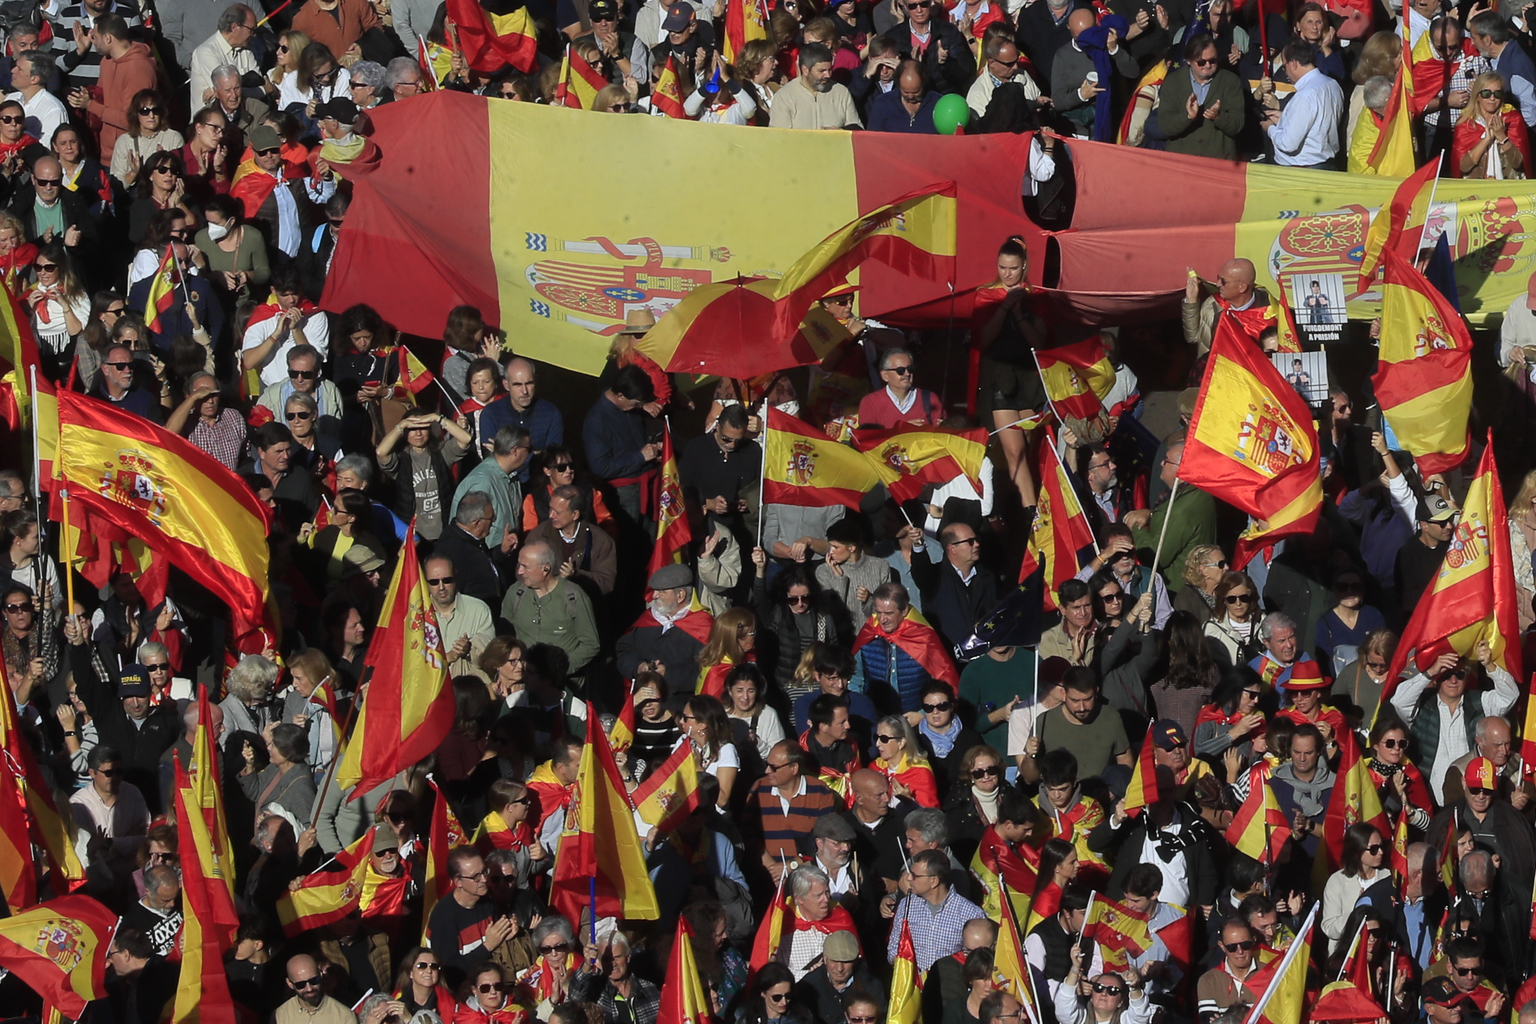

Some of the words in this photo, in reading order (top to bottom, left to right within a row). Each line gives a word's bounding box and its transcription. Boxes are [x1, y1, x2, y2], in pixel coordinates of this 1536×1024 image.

[645, 242, 661, 263] PLVS
[1303, 324, 1343, 332] PUIGDEMONT
[1308, 333, 1314, 341] A
[1314, 332, 1340, 341] PRISIÓN
[121, 674, 142, 685] ESPAÑA
